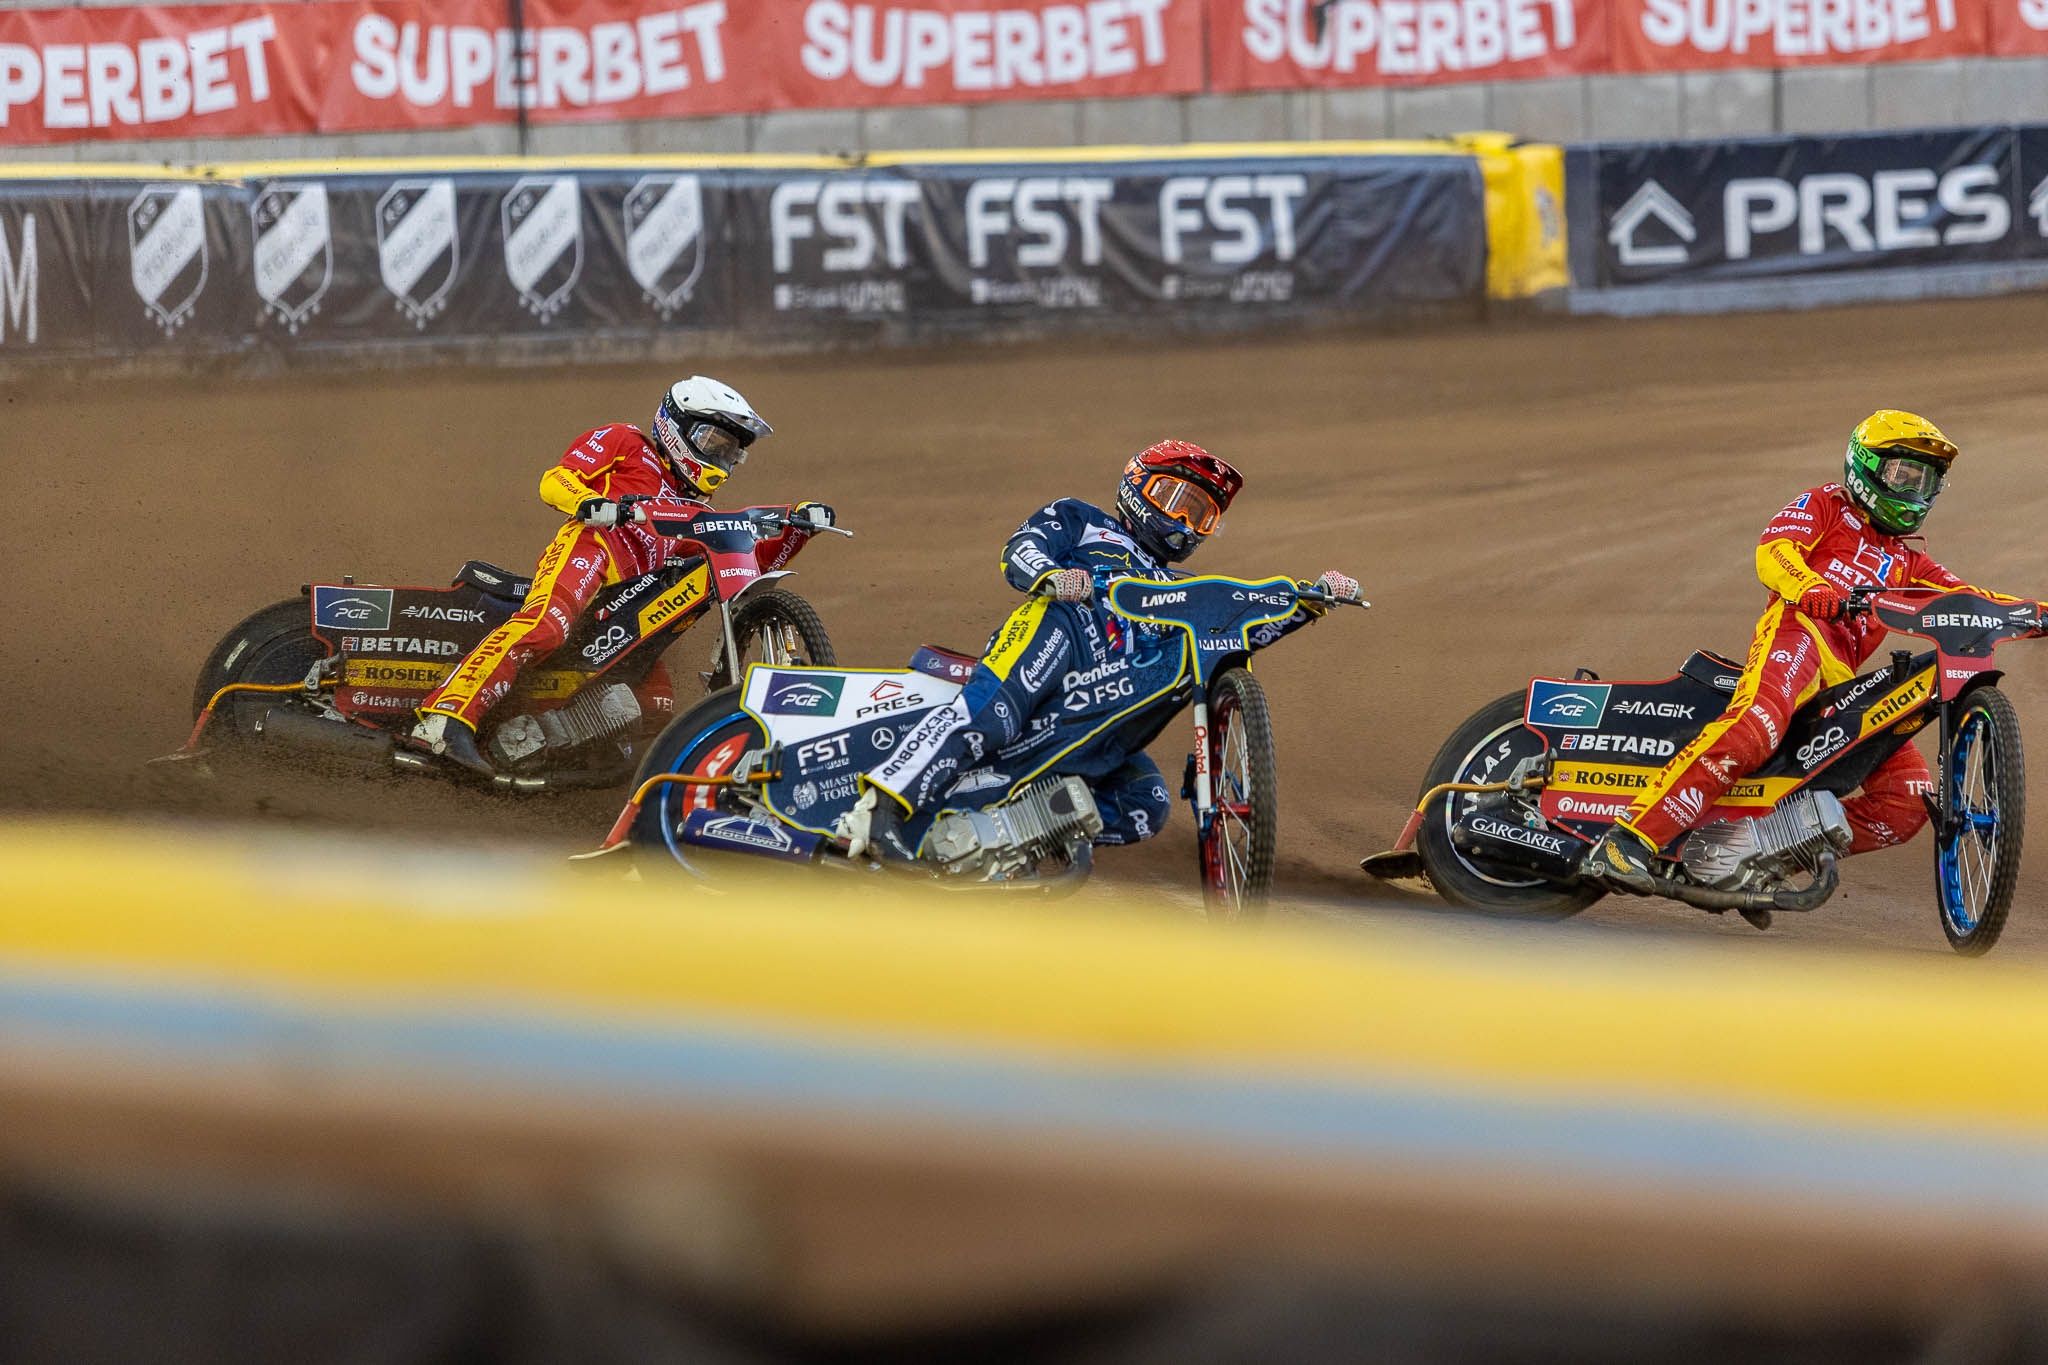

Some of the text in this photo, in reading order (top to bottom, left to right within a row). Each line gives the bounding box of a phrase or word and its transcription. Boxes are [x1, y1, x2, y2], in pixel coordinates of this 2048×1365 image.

[801, 0, 1168, 89] SUPERBET
[1243, 0, 1575, 75] SUPERBET
[351, 1, 727, 109] SUPERBET
[0, 15, 276, 130] PERBET
[772, 181, 921, 272] FST
[964, 179, 1113, 268] FST
[1160, 175, 1305, 264] FST
[1724, 165, 2010, 260] PRES
[706, 520, 757, 539] BETARD
[720, 569, 757, 578] BECKHOFF
[1828, 558, 1876, 588] BETA
[606, 573, 658, 612] UniCredit
[647, 582, 699, 625] milart
[1141, 591, 1187, 608] LAVOR
[334, 608, 371, 619] PGE
[1937, 614, 2003, 630] BETARD
[361, 637, 459, 656] BETARD
[459, 631, 510, 683] milart
[1199, 638, 1241, 650] MAK
[365, 667, 442, 682] ROSIEK
[1063, 658, 1129, 693] Pentel
[1094, 677, 1134, 704] FSG
[1835, 668, 1890, 711] UniCredit
[782, 694, 821, 707] PGE
[856, 693, 924, 718] PRES
[1549, 704, 1587, 717] PGE
[1870, 680, 1926, 726] milart
[797, 733, 850, 768] FST
[883, 716, 939, 777] EXPOBUD
[1579, 734, 1675, 757] BETARD
[1575, 771, 1649, 788] ROSIEK
[1472, 818, 1566, 852] GARCAREK
